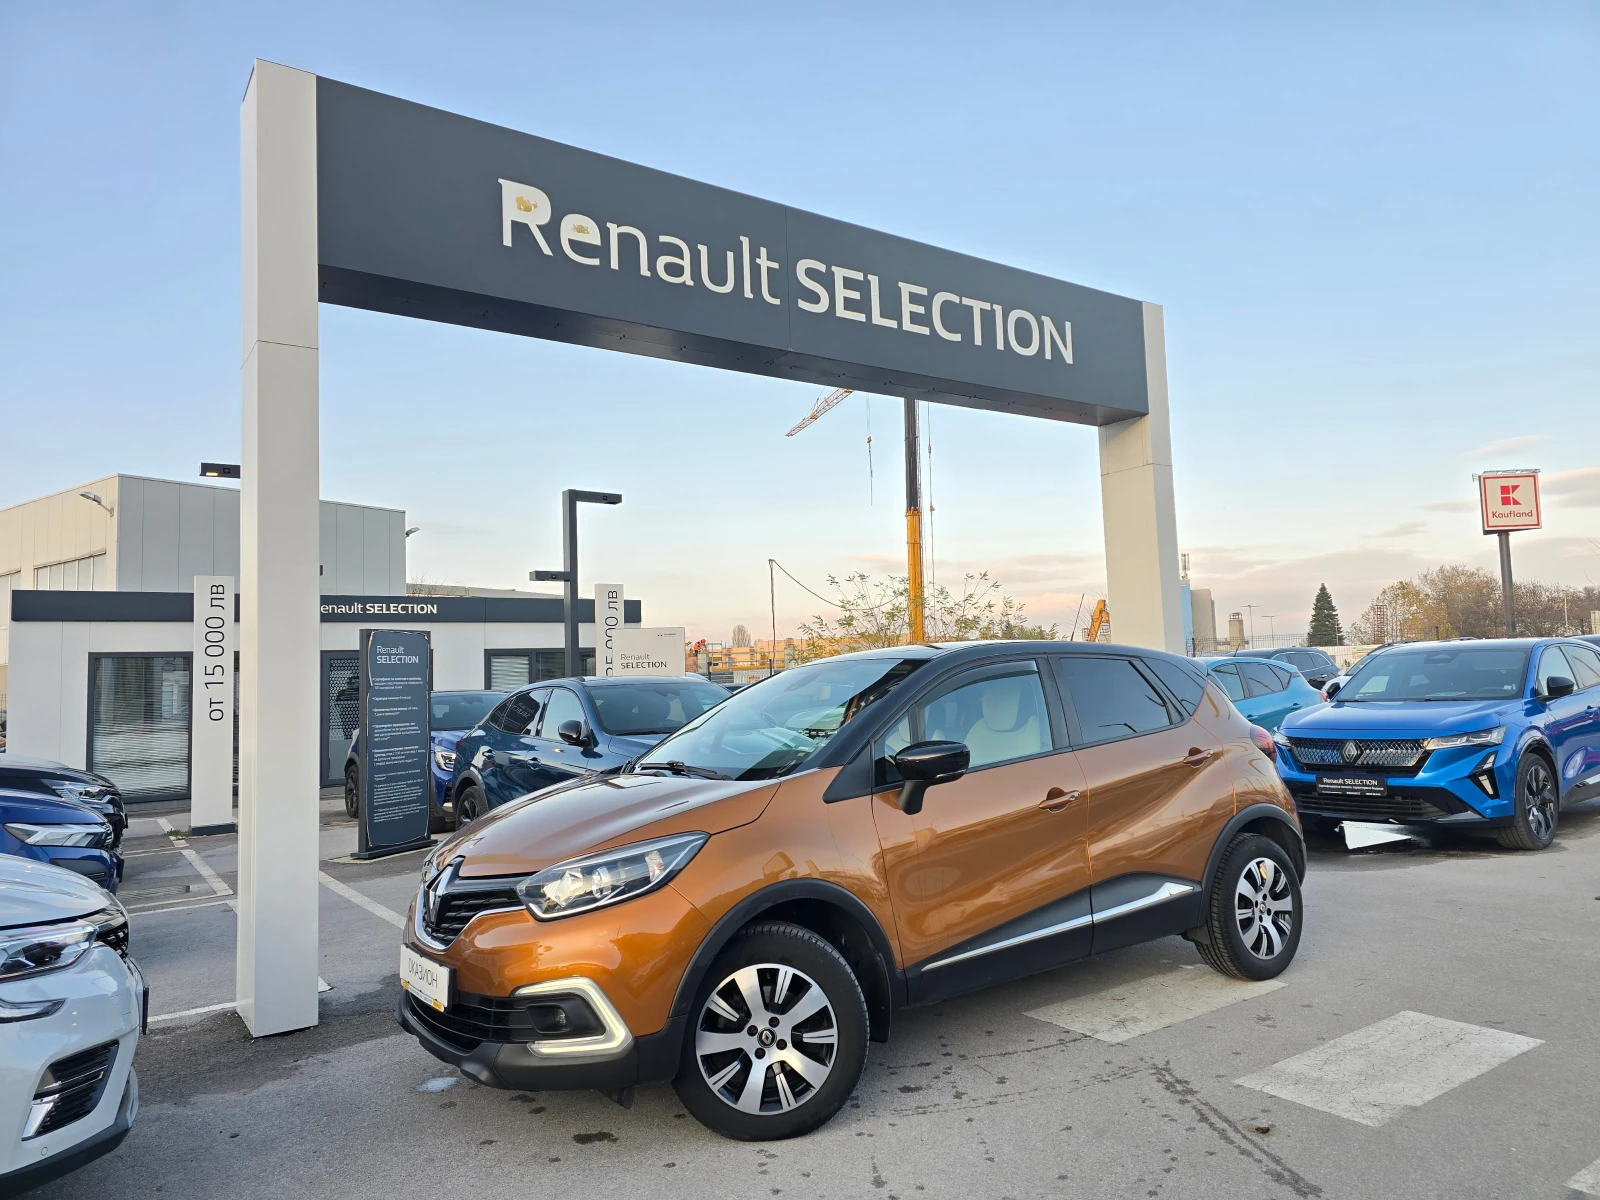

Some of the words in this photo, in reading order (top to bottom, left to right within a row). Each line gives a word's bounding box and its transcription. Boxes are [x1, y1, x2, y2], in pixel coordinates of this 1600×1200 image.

[498, 178, 781, 305] Renault
[796, 258, 1074, 365] SELECTION
[1491, 510, 1533, 518] Kaufland
[320, 602, 364, 614] enault
[365, 603, 437, 614] SELECTION
[204, 616, 225, 657] 000
[376, 645, 405, 654] Renault
[376, 655, 419, 664] SELECTION
[620, 653, 651, 661] Renault
[620, 661, 667, 670] SELECTION
[204, 665, 225, 690] 15
